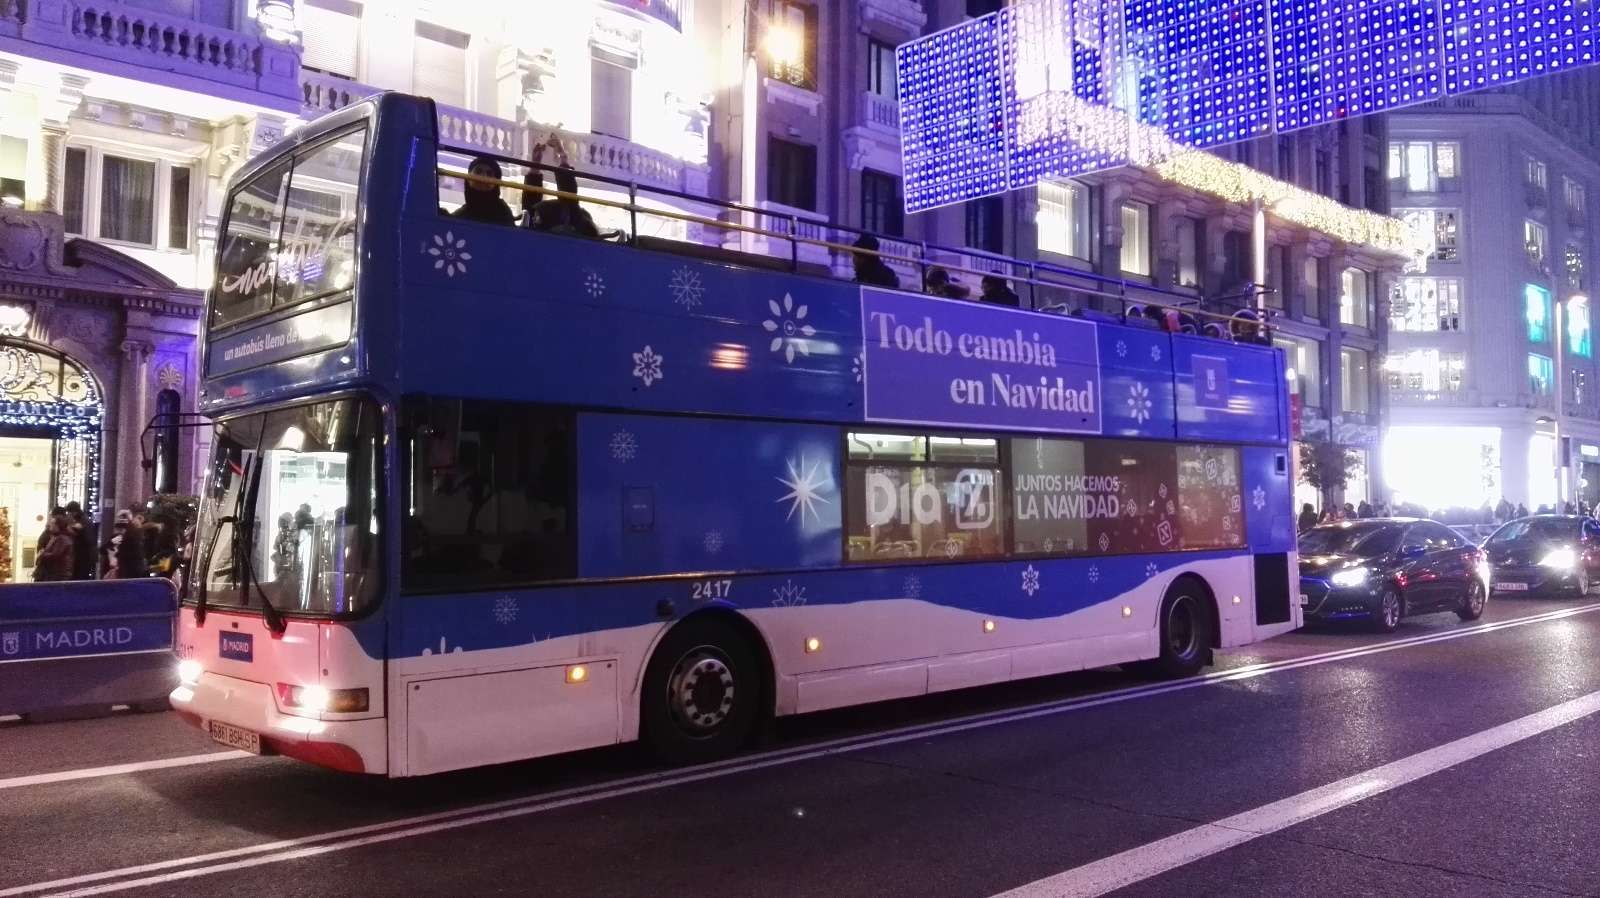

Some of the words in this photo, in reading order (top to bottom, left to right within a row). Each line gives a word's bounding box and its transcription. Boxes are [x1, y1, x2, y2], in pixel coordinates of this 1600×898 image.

[224, 349, 234, 360] un
[234, 336, 264, 358] autobús
[265, 333, 285, 352] lleno
[870, 311, 952, 355] Todo
[958, 329, 1056, 368] cambia
[951, 377, 984, 405] en
[991, 373, 1094, 413] Navidad
[1015, 474, 1061, 492] JUNTOS
[1064, 475, 1120, 492] HACEMOS
[1018, 497, 1040, 519] LA
[1046, 496, 1119, 519] NAVIDAD
[692, 580, 732, 599] 2417
[36, 627, 133, 649] MADRID
[228, 641, 249, 653] MADRID
